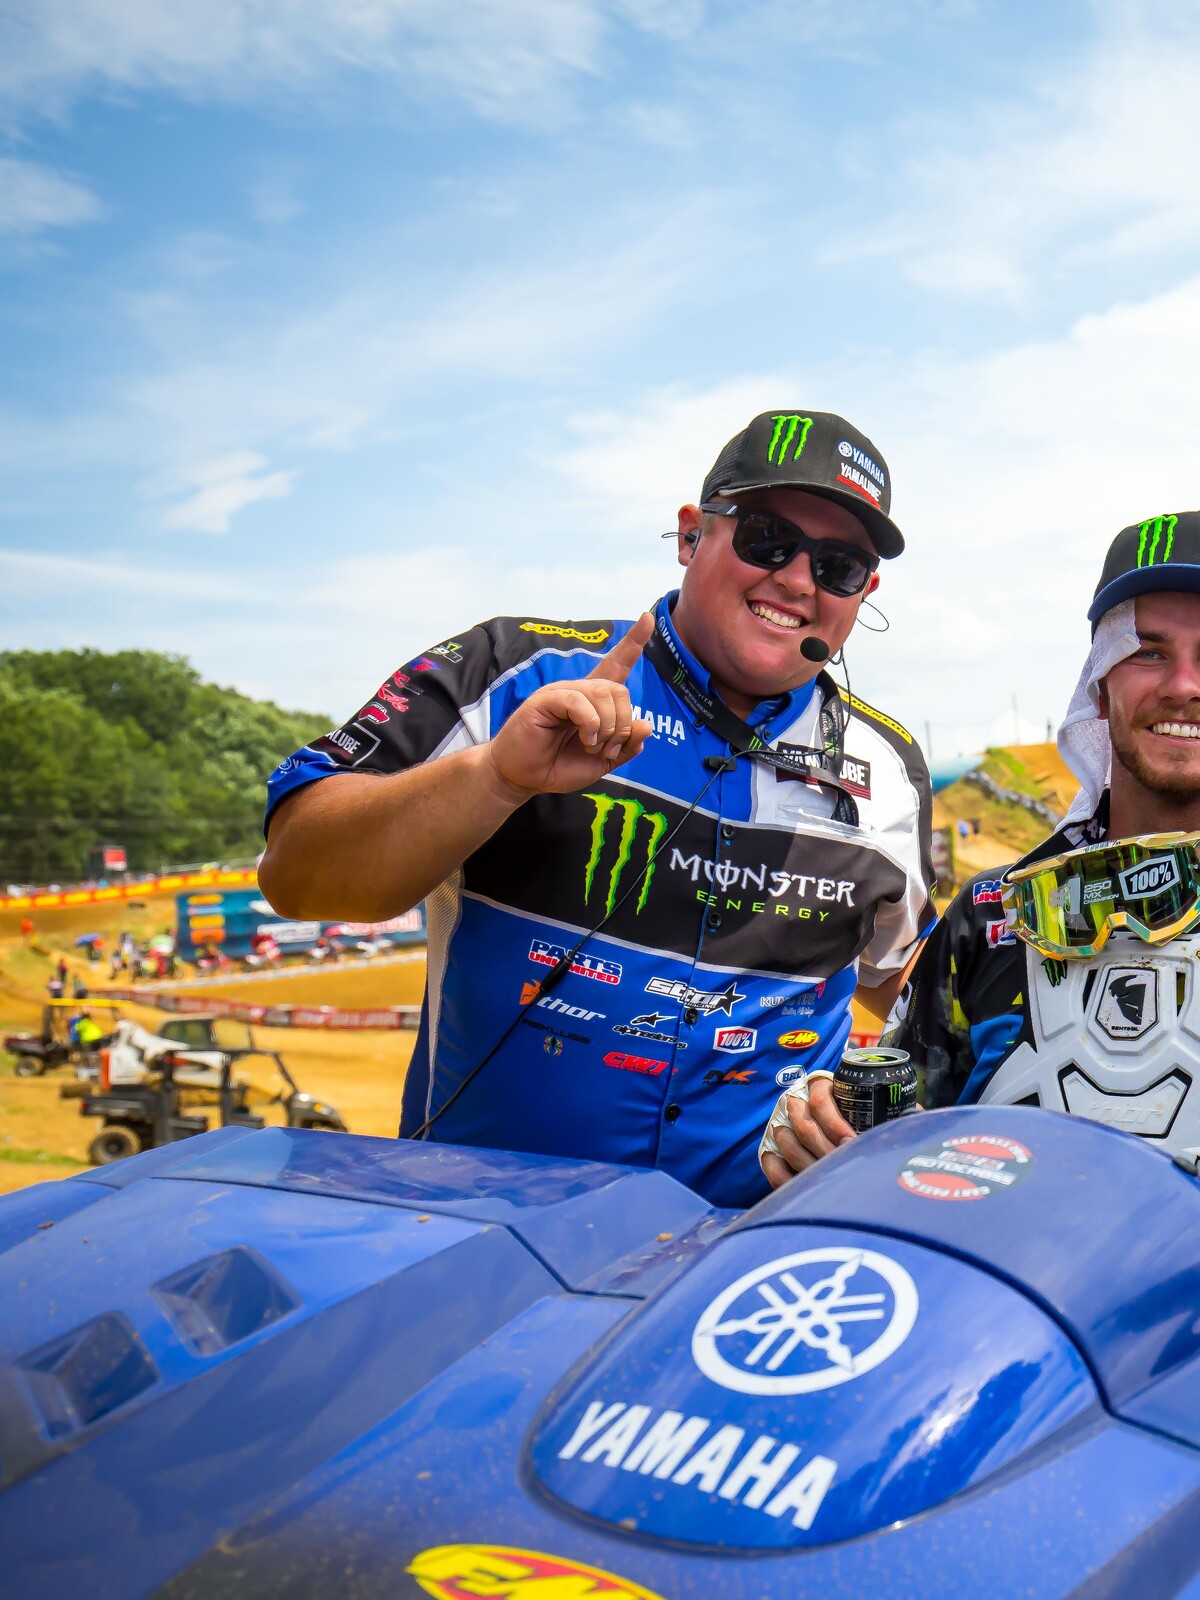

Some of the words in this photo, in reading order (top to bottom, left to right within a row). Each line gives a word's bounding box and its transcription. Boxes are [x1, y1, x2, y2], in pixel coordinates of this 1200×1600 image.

[851, 447, 885, 488] YAMAHA
[1129, 862, 1173, 893] 100%
[1084, 879, 1113, 894] 250
[1083, 890, 1103, 901] MX
[1083, 893, 1121, 905] CHAMPION
[536, 996, 607, 1022] thor
[718, 1032, 753, 1048] 100%
[779, 1031, 818, 1046] FMF
[557, 1400, 839, 1532] YAMAHA
